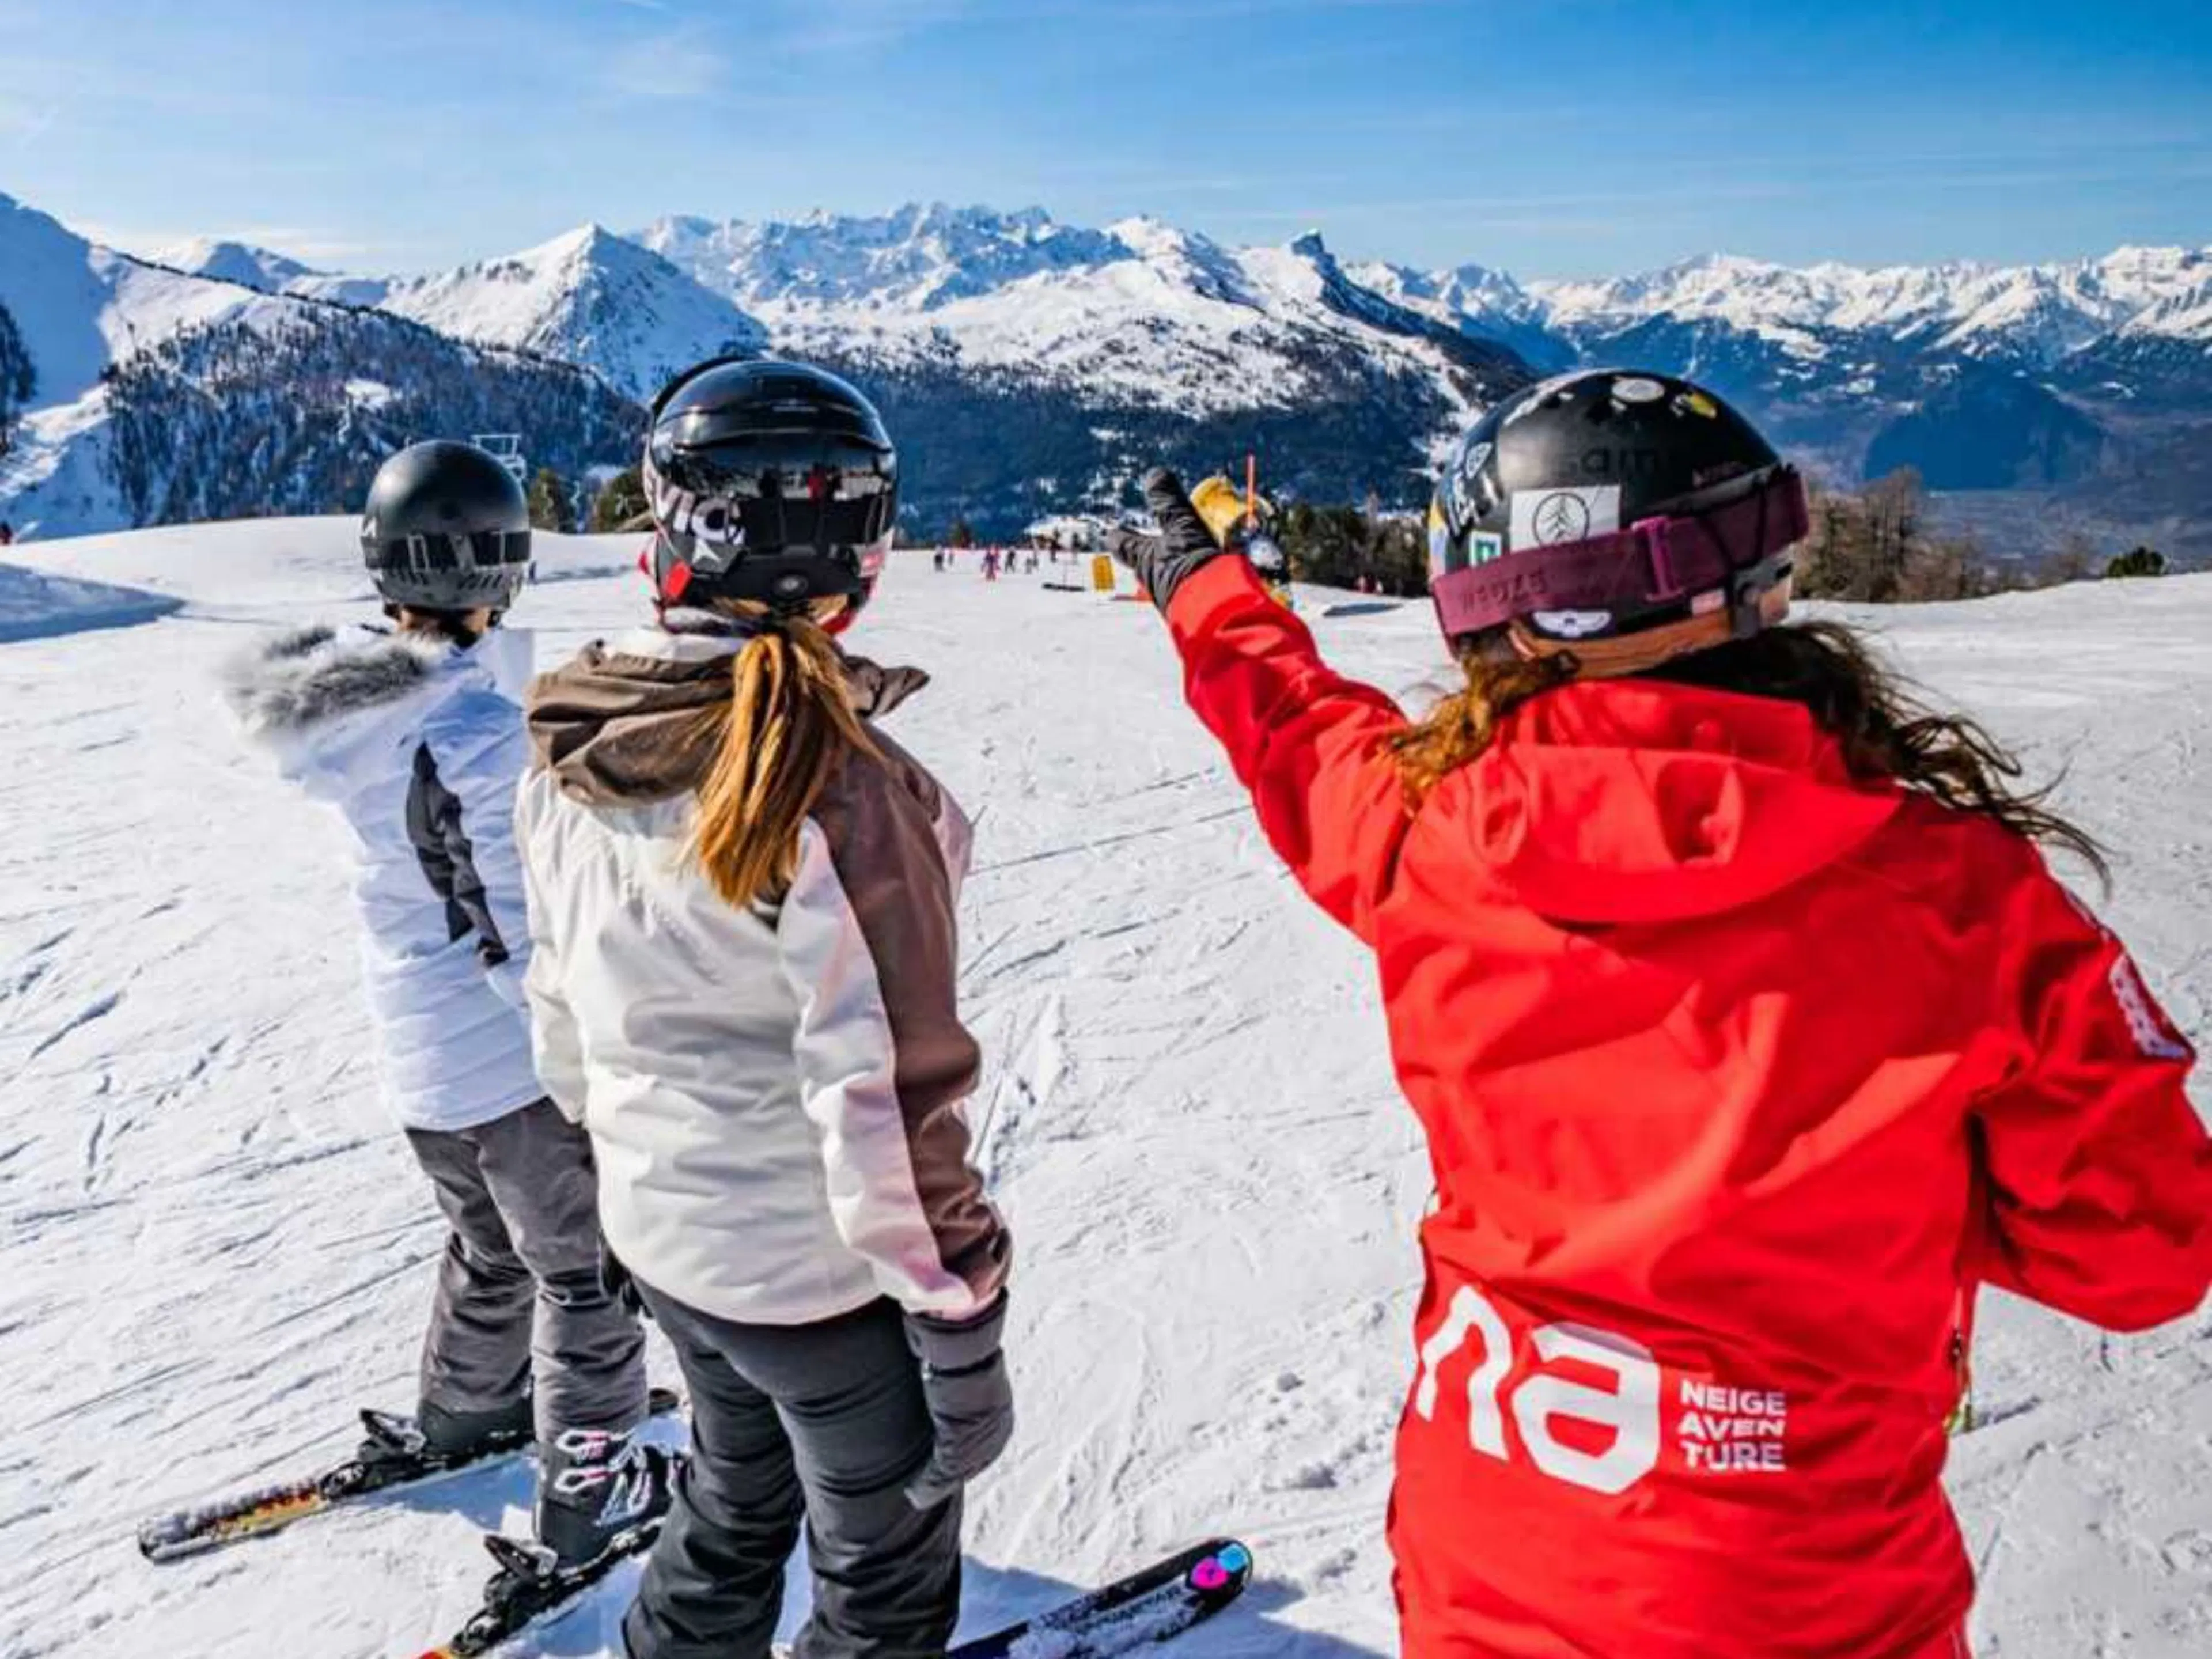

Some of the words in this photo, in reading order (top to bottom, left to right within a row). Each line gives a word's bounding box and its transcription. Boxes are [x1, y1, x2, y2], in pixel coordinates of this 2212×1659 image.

[1680, 1380, 1786, 1416] NEIGE
[1678, 1411, 1785, 1440] AVEN
[1679, 1441, 1785, 1471] TURE
